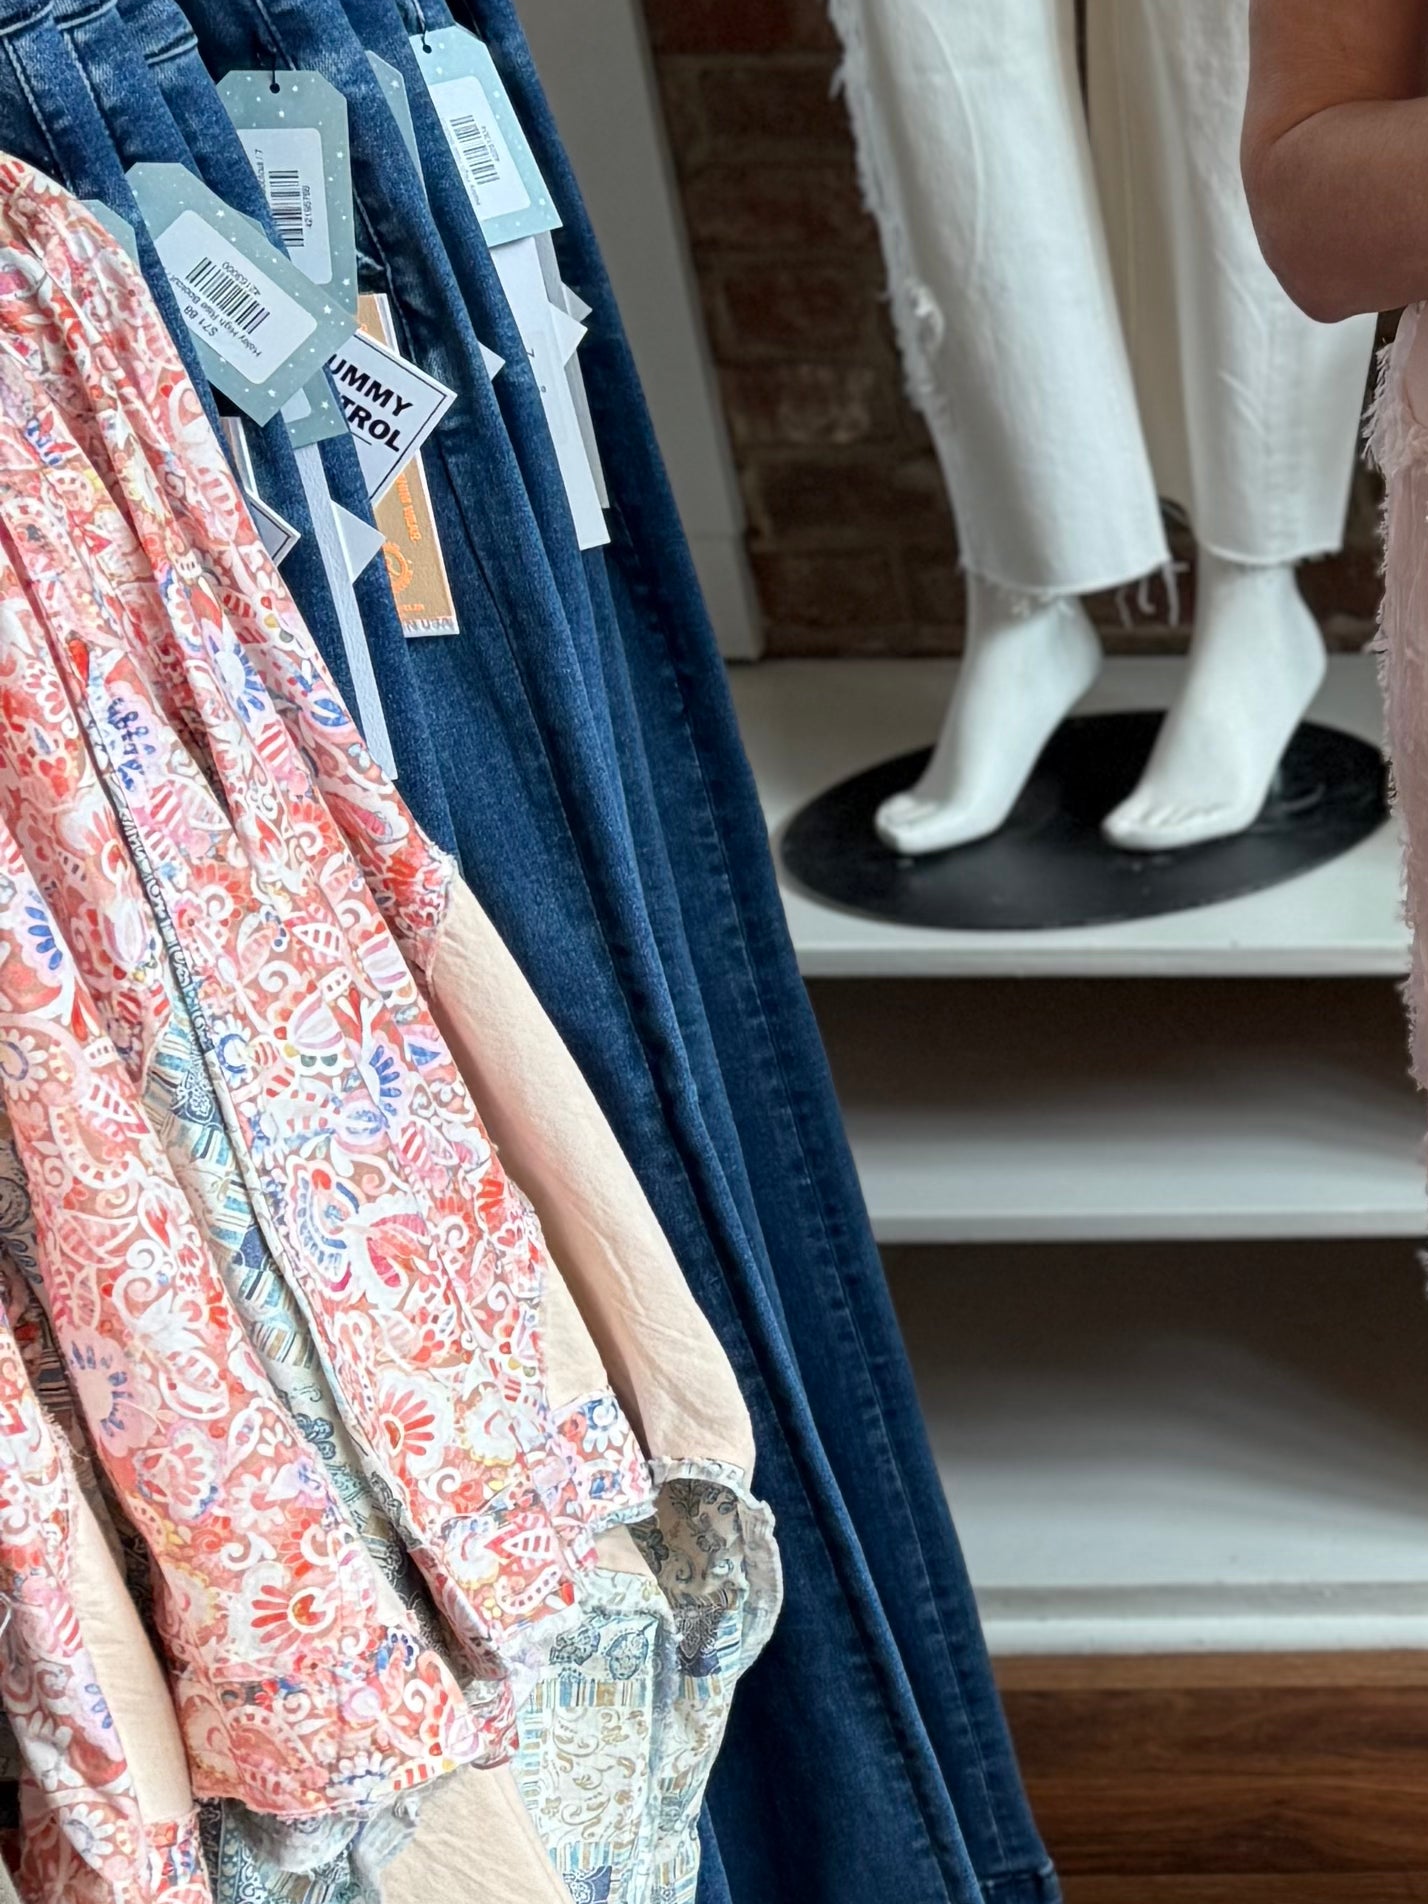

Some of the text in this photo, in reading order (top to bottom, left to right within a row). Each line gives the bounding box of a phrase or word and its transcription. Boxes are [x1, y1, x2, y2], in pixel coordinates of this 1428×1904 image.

[201, 302, 220, 321] Rise
[219, 318, 238, 337] High
[327, 353, 413, 417] UMMY
[341, 395, 401, 452] TROL
